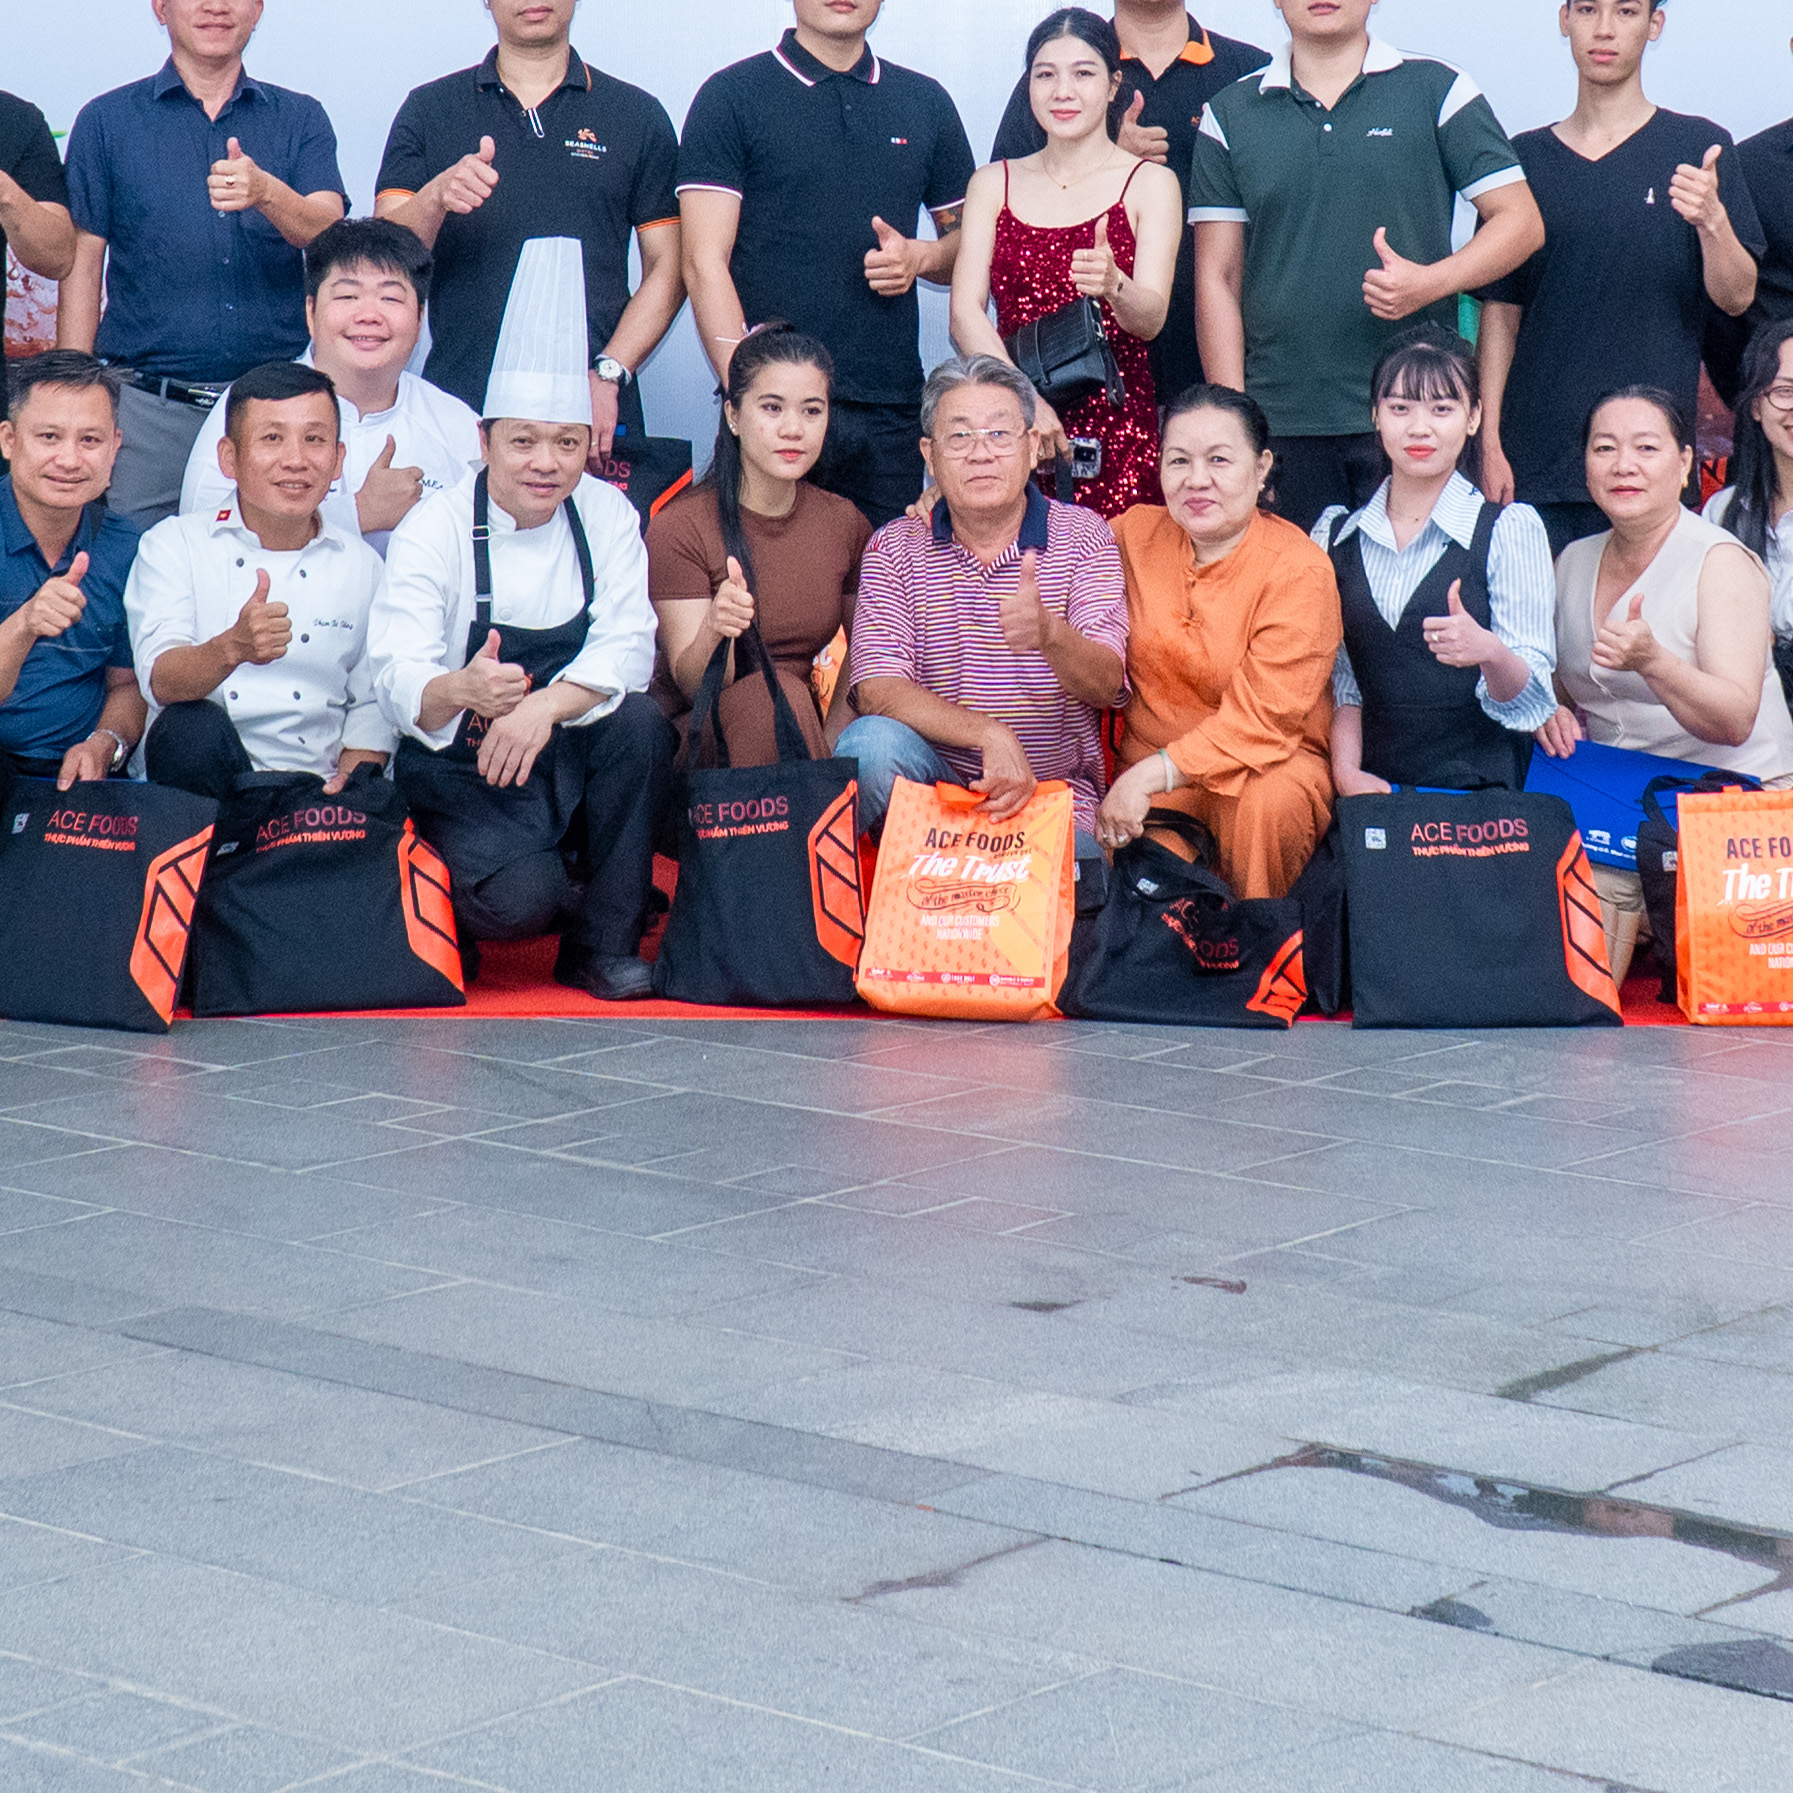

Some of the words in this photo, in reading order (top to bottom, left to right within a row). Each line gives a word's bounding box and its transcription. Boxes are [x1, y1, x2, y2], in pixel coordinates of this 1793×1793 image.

[718, 795, 789, 823] FOODS
[46, 809, 88, 831] ACE
[88, 814, 139, 836] FOODS
[255, 815, 290, 842] ACE
[1411, 821, 1453, 842] ACE
[1455, 817, 1529, 843] FOODS
[925, 827, 963, 849] ACE
[965, 830, 1026, 853] FOODS
[1726, 837, 1763, 859] ACE
[905, 850, 959, 879] The
[960, 853, 1033, 884] Trust
[1719, 862, 1772, 904] The
[920, 914, 938, 927] AND
[954, 914, 1000, 928] CUSTOMERS
[936, 928, 983, 940] NATIONWIDE
[1749, 943, 1767, 956] AND
[1767, 942, 1785, 956] OUR
